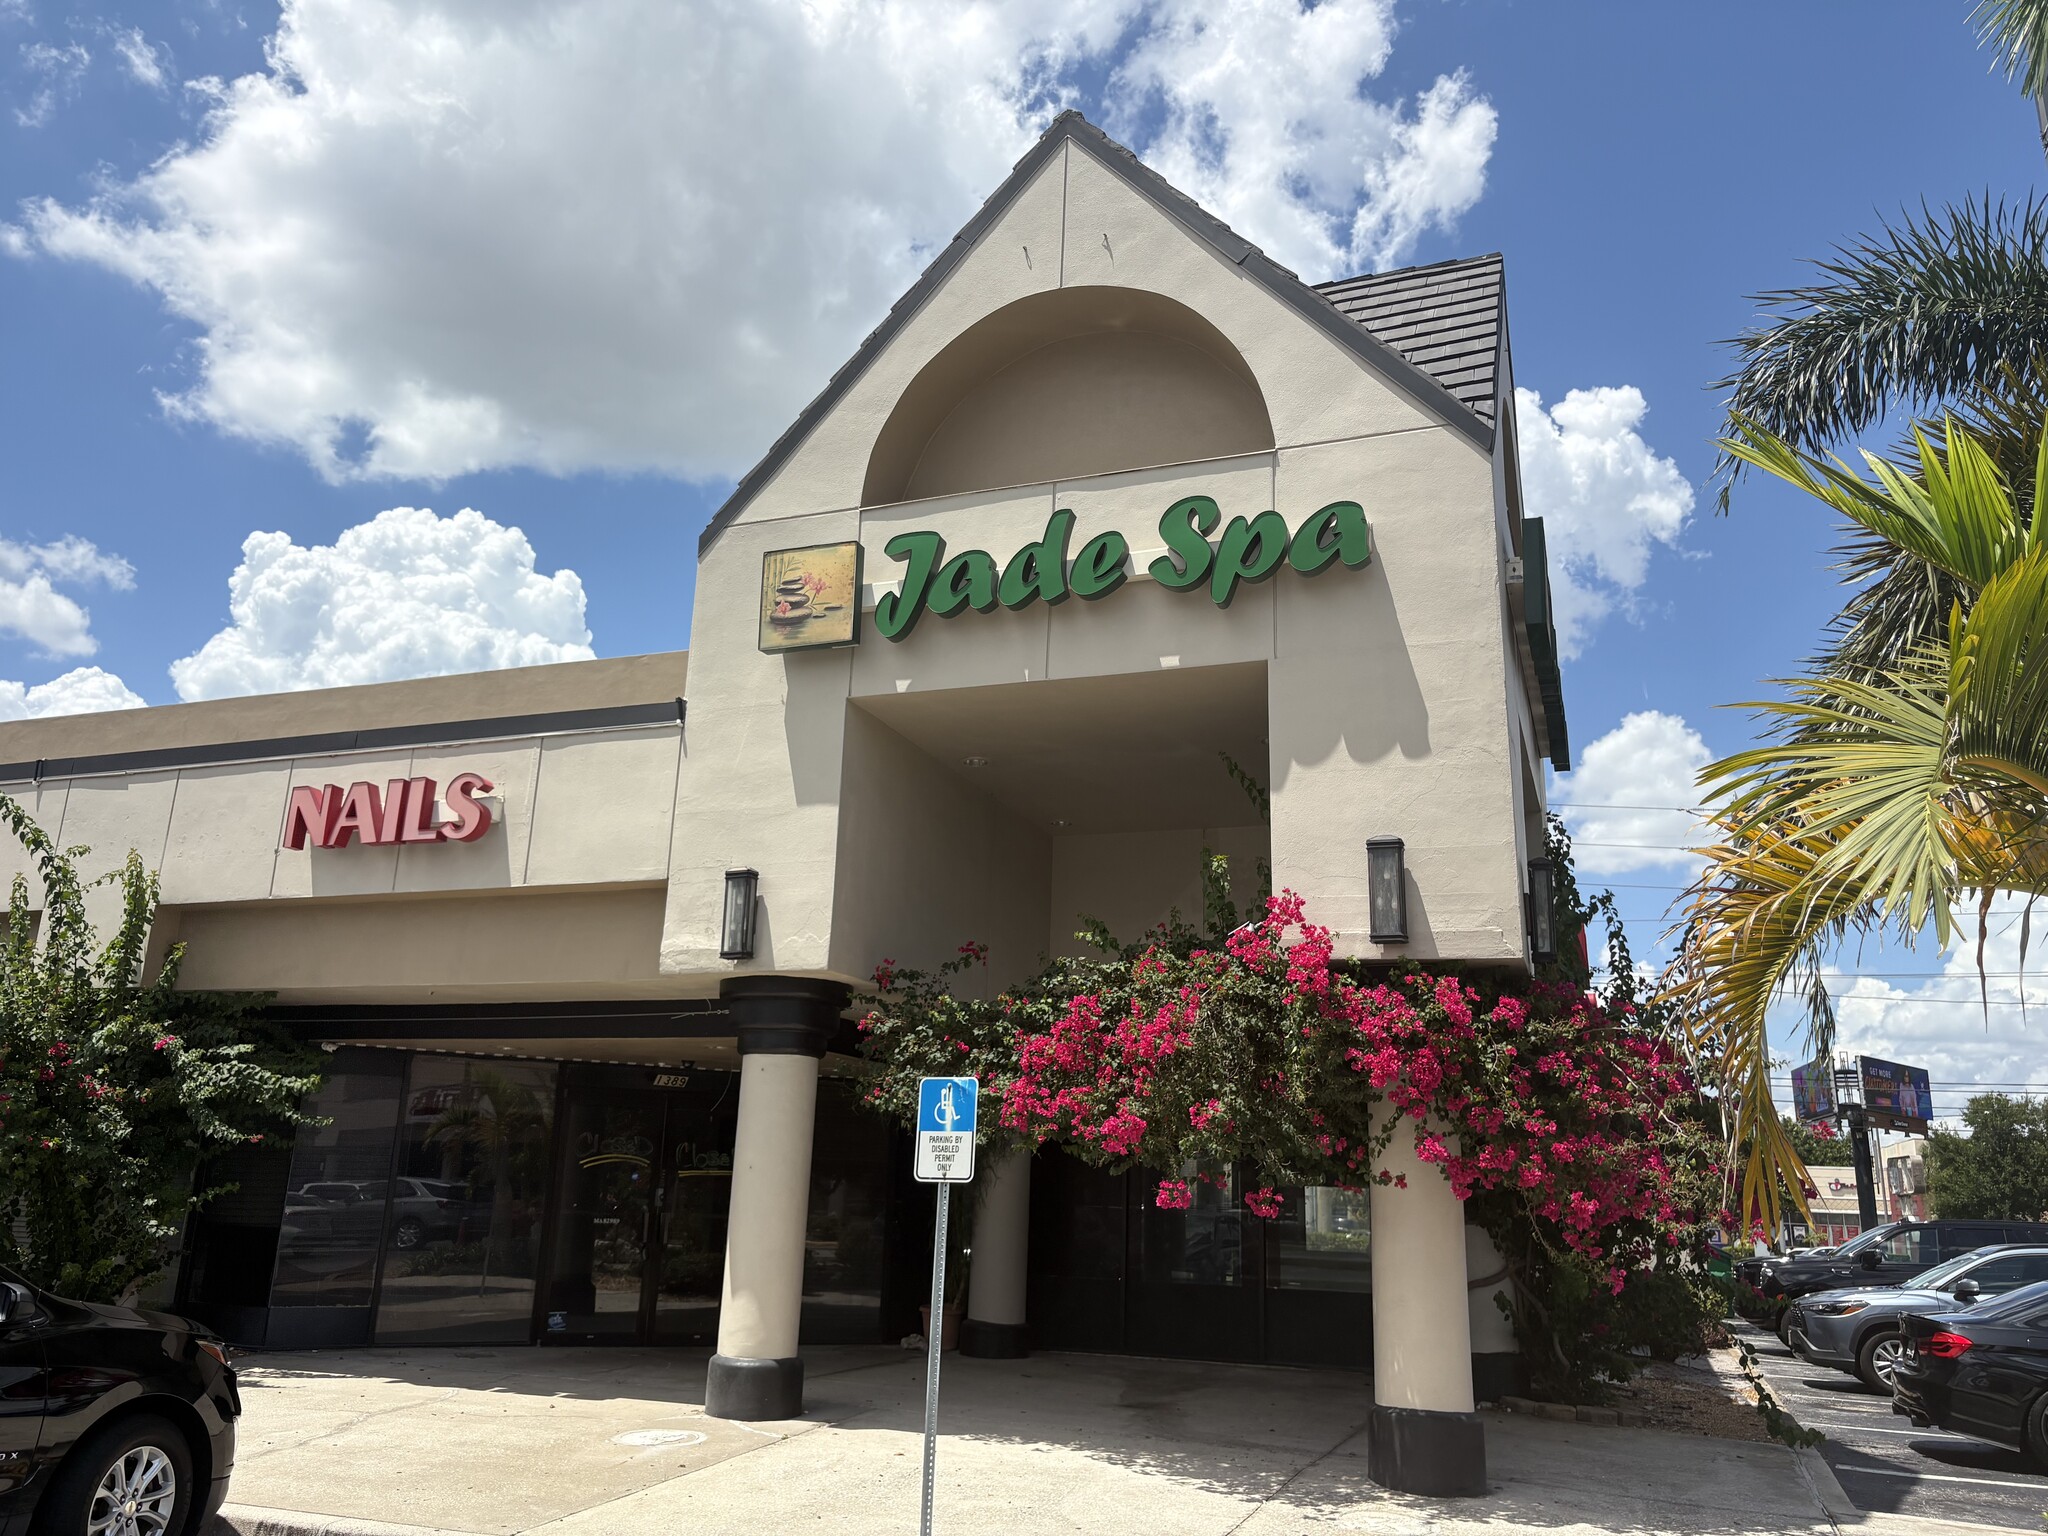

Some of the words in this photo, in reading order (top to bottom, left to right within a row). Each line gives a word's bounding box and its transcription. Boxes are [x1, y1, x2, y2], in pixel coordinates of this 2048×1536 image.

[874, 509, 1130, 643] Jade
[1148, 495, 1374, 609] Spa
[283, 772, 495, 851] NAILS
[657, 1075, 686, 1087] 1389
[931, 1145, 960, 1153] DISABLED
[934, 1154, 955, 1162] PERMIT
[937, 1163, 952, 1171] ONLY
